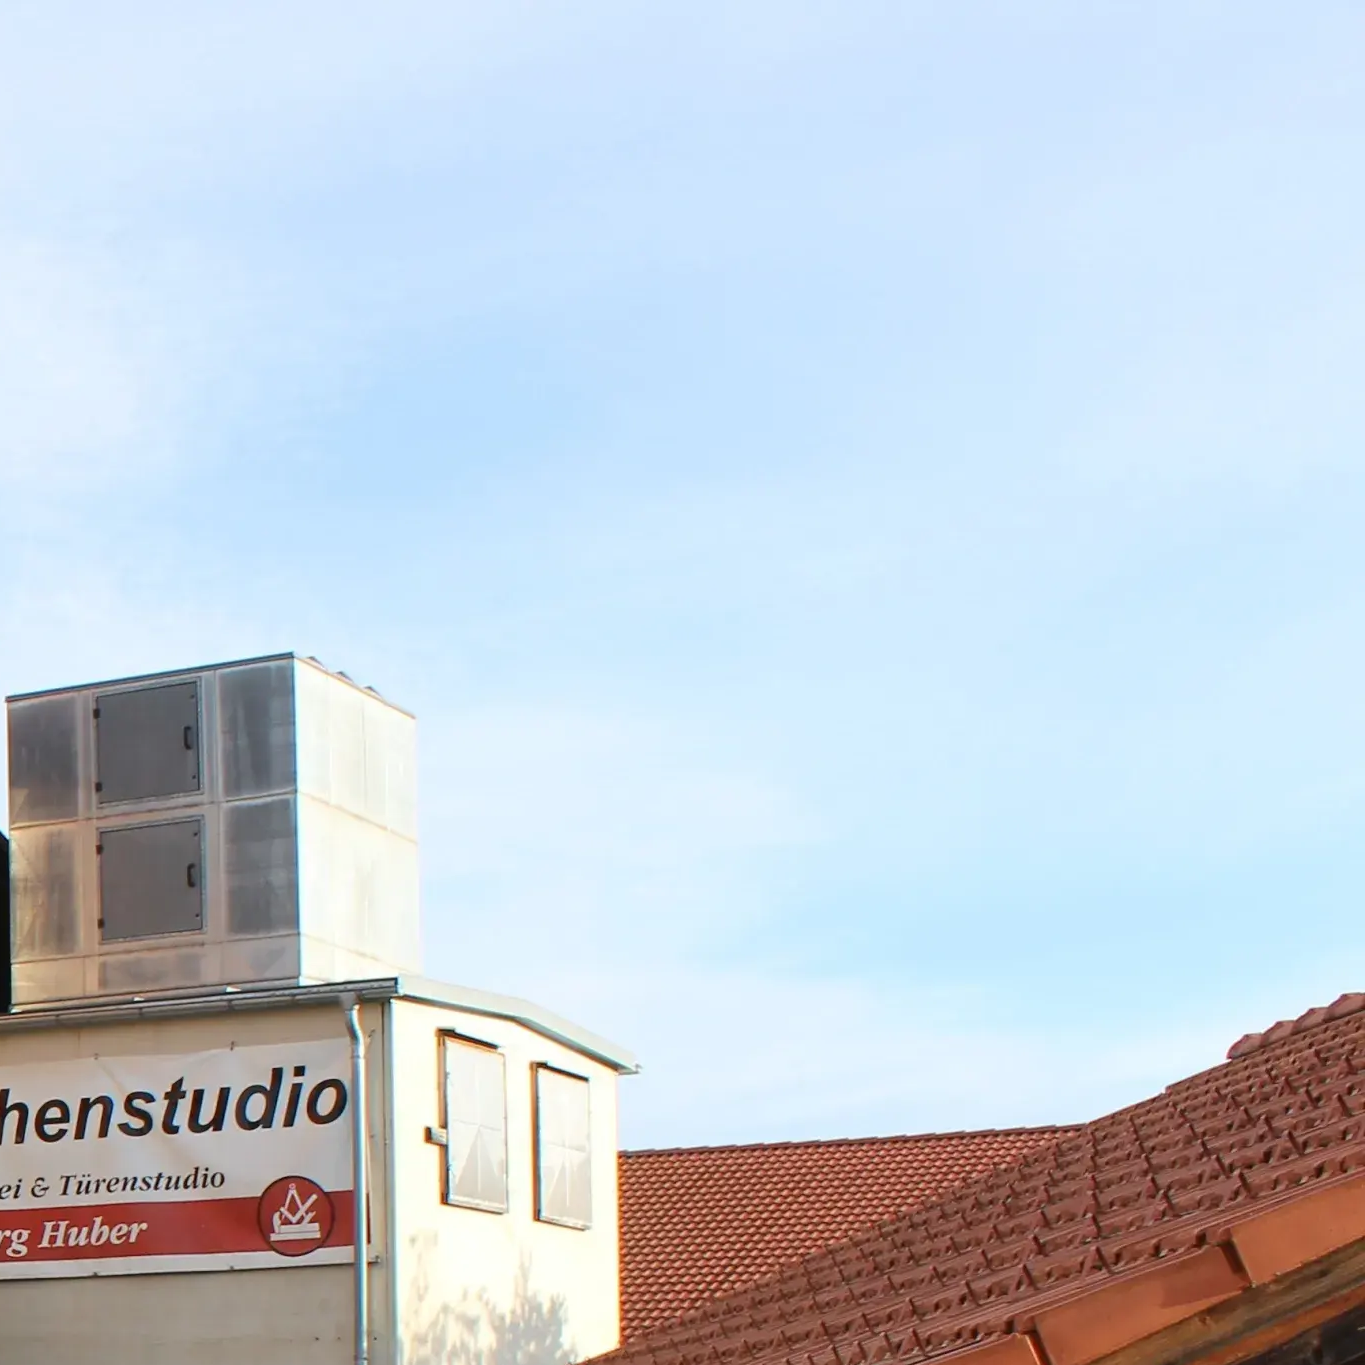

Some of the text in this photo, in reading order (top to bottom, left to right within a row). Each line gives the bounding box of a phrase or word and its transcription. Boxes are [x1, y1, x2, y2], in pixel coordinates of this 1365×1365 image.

[31, 1177, 50, 1198] &
[59, 1166, 226, 1194] Türenstudio
[37, 1219, 149, 1249] Huber
